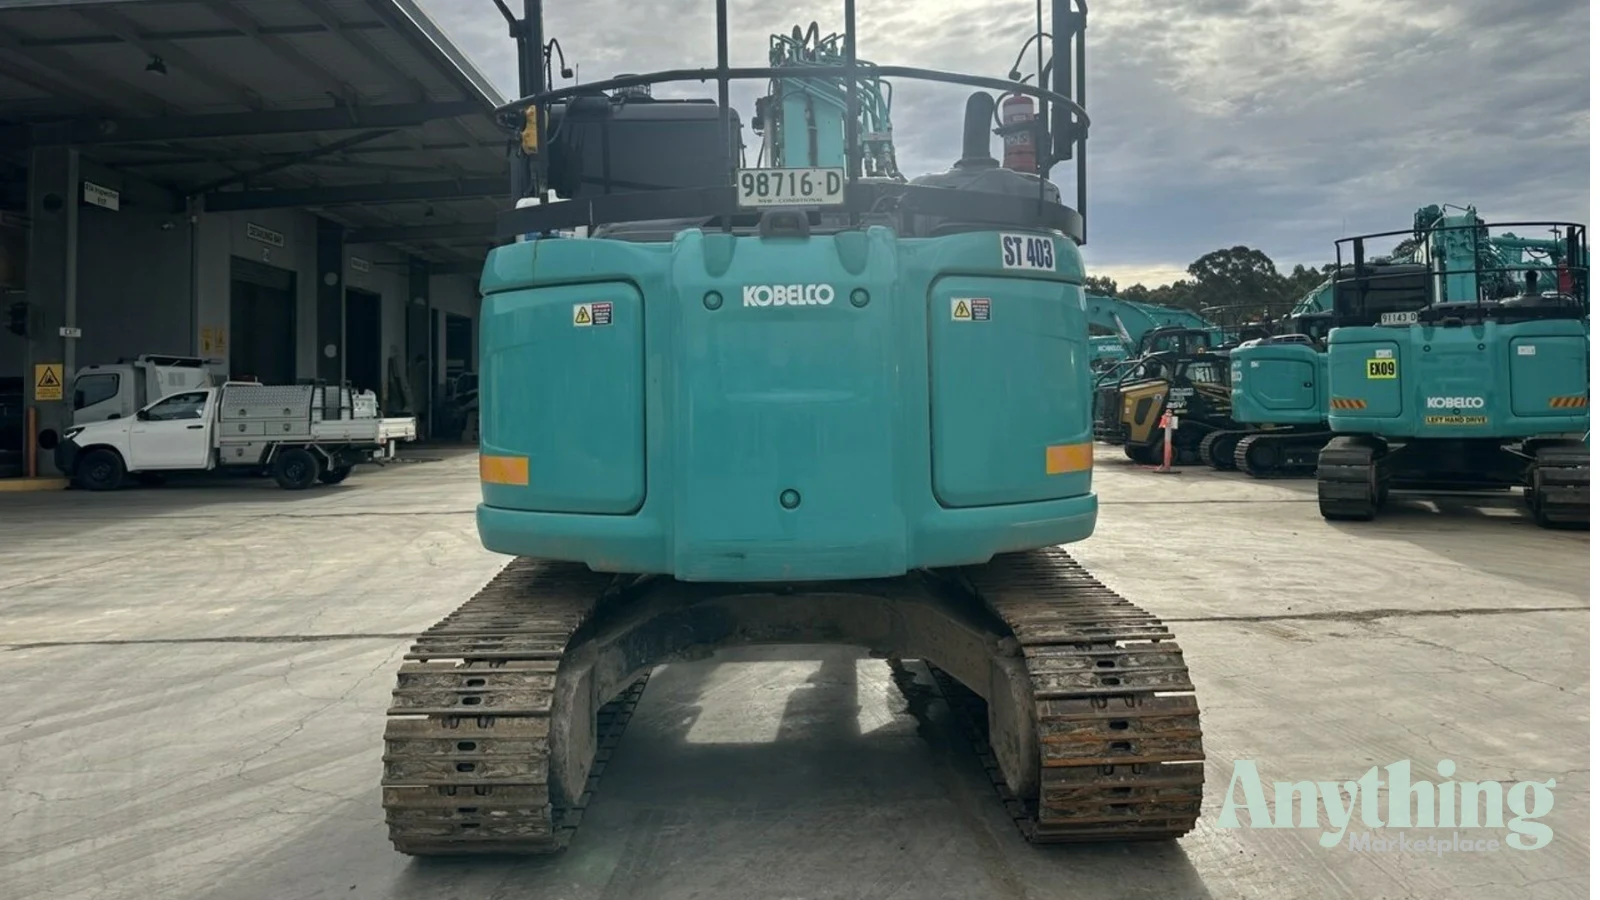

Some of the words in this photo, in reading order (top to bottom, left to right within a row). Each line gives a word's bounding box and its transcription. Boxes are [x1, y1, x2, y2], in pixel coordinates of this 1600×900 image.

[1003, 236, 1023, 267] ST
[1026, 237, 1054, 269] 403
[743, 283, 835, 307] KOBELCO
[1381, 313, 1408, 322] 91143
[1369, 361, 1395, 376] EX09
[1427, 396, 1484, 409] KOBELCO
[1427, 416, 1444, 424] LEFT
[1445, 416, 1464, 424] HAND
[1465, 416, 1486, 424] DRIVE
